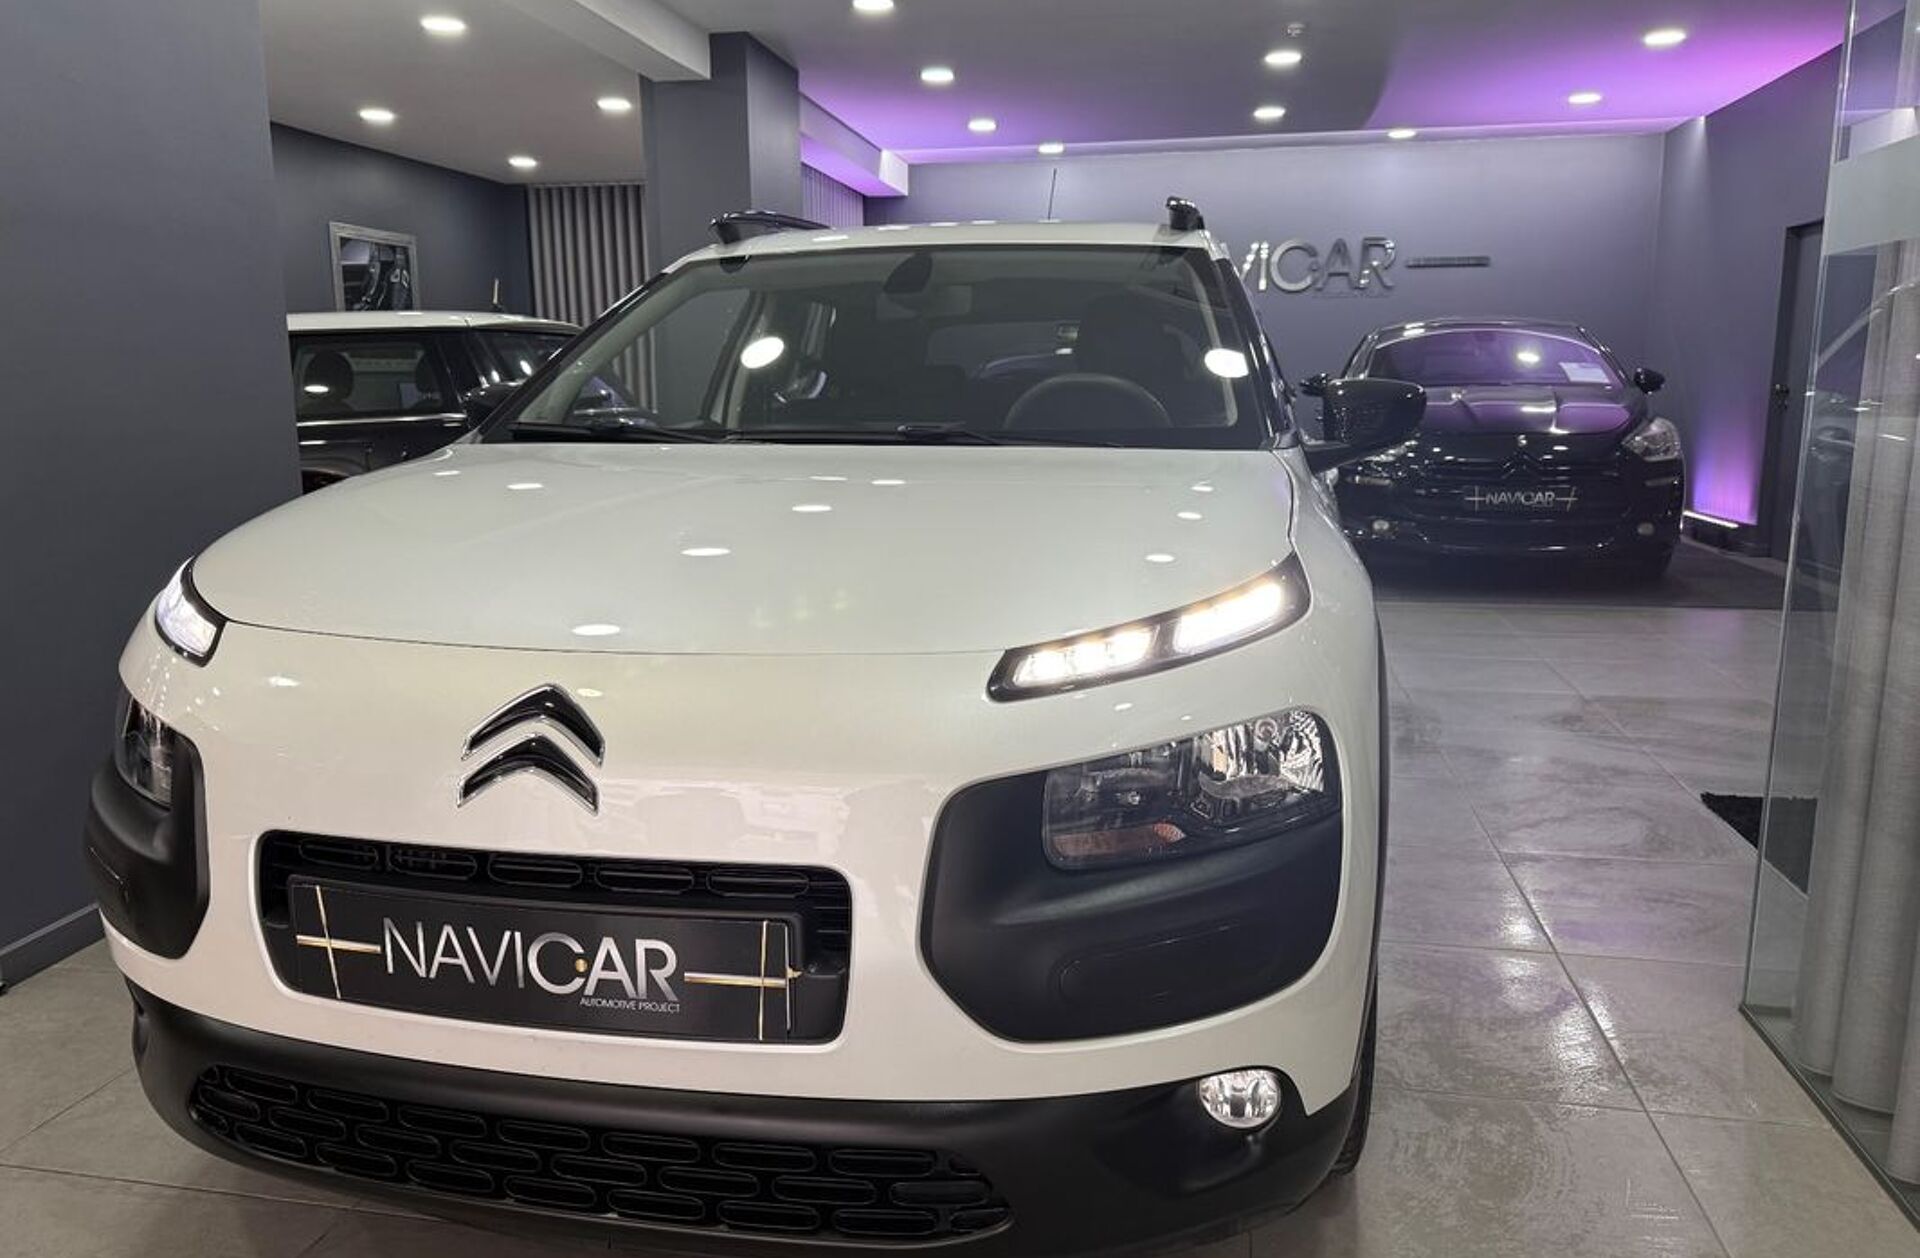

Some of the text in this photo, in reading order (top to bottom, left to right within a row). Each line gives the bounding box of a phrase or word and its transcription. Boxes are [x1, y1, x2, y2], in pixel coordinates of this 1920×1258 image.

[1486, 492, 1555, 506] NAVICAR
[384, 917, 678, 1001] NAVICAR
[580, 998, 680, 1013] AUTOMOTIVE PROJECT
